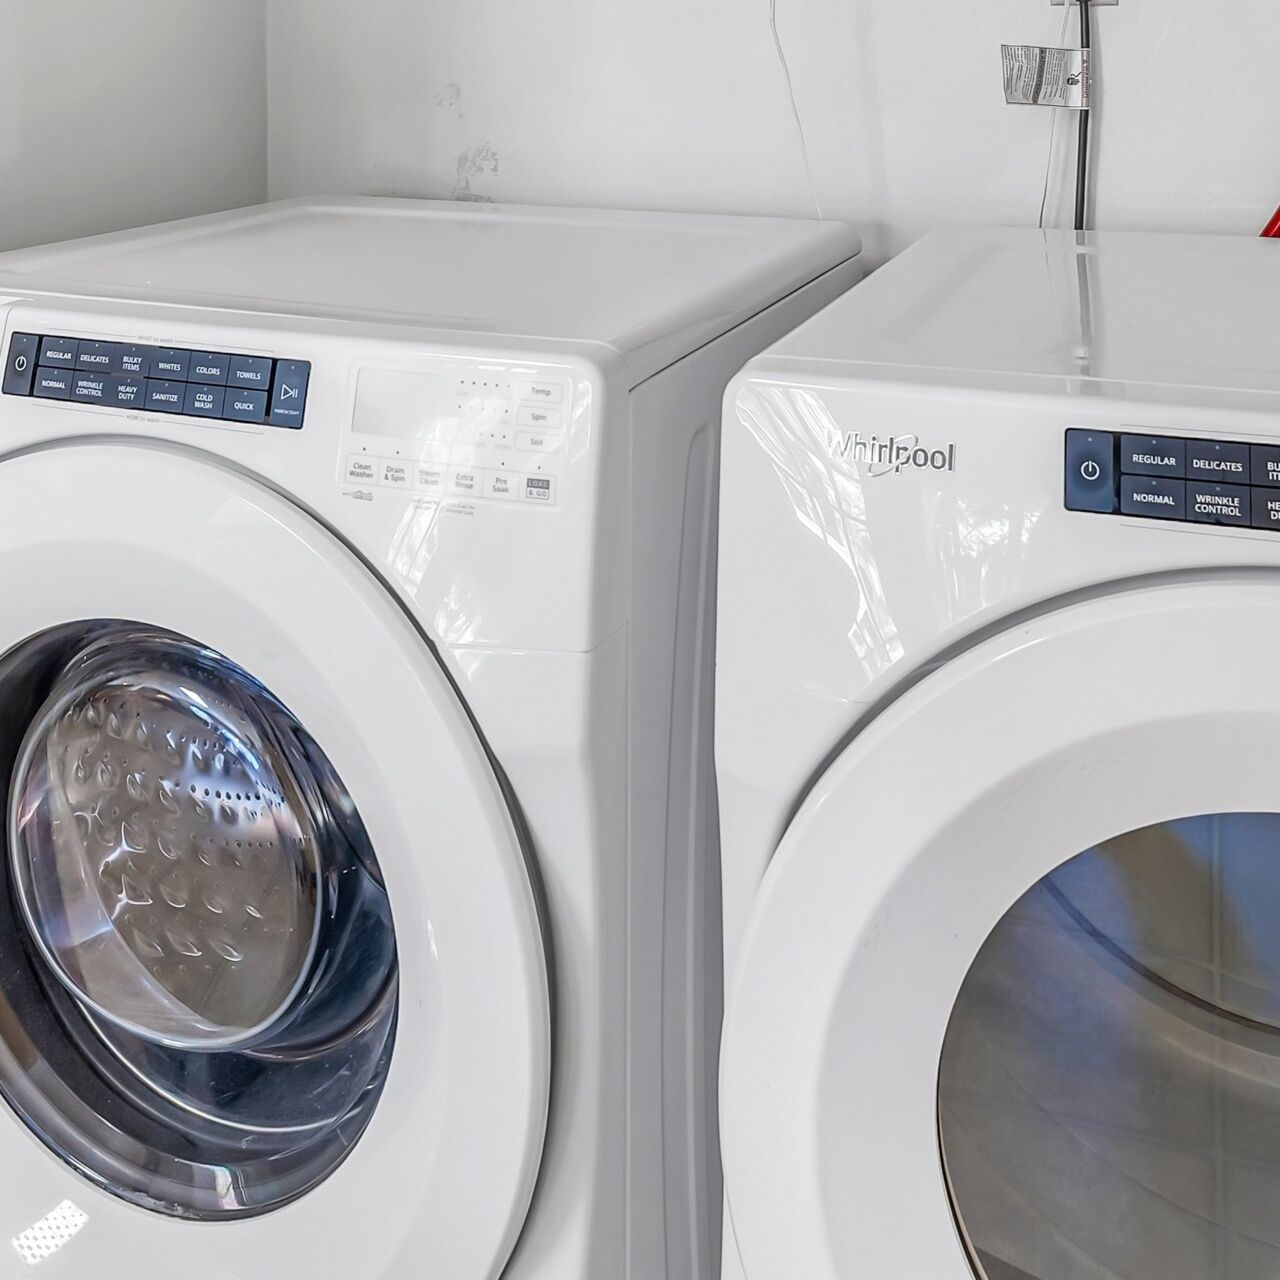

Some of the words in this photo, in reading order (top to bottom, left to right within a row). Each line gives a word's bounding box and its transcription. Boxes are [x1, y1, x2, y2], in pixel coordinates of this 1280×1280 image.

[46, 350, 72, 359] REGULAR
[80, 355, 109, 364] DELICATES
[122, 355, 142, 364] BULKY
[122, 363, 140, 371] ITEMS
[158, 362, 181, 371] WHITES
[196, 366, 221, 375] COLORS
[236, 371, 261, 380] TOWELS
[41, 380, 66, 389] NORMAL
[78, 380, 103, 389] WRINKLE
[118, 385, 138, 393] HEAVY
[76, 388, 102, 397] CONTROL
[531, 387, 551, 397] Temp
[152, 392, 178, 402] SANITIZE
[196, 393, 213, 402] COLD
[195, 401, 213, 409] WASH
[234, 401, 255, 411] QUICK
[825, 429, 955, 476] Whirlpool
[1132, 453, 1177, 467] REGULAR
[353, 462, 371, 471] Clean
[386, 466, 405, 474] Drain
[1193, 459, 1243, 472] DELICATES
[349, 470, 374, 479] Washer
[391, 474, 406, 482] Spin
[492, 485, 509, 493] Soak
[1132, 492, 1175, 505] NORMAL
[1195, 494, 1240, 507] WRINKLE
[1194, 503, 1242, 517] CONTROL
